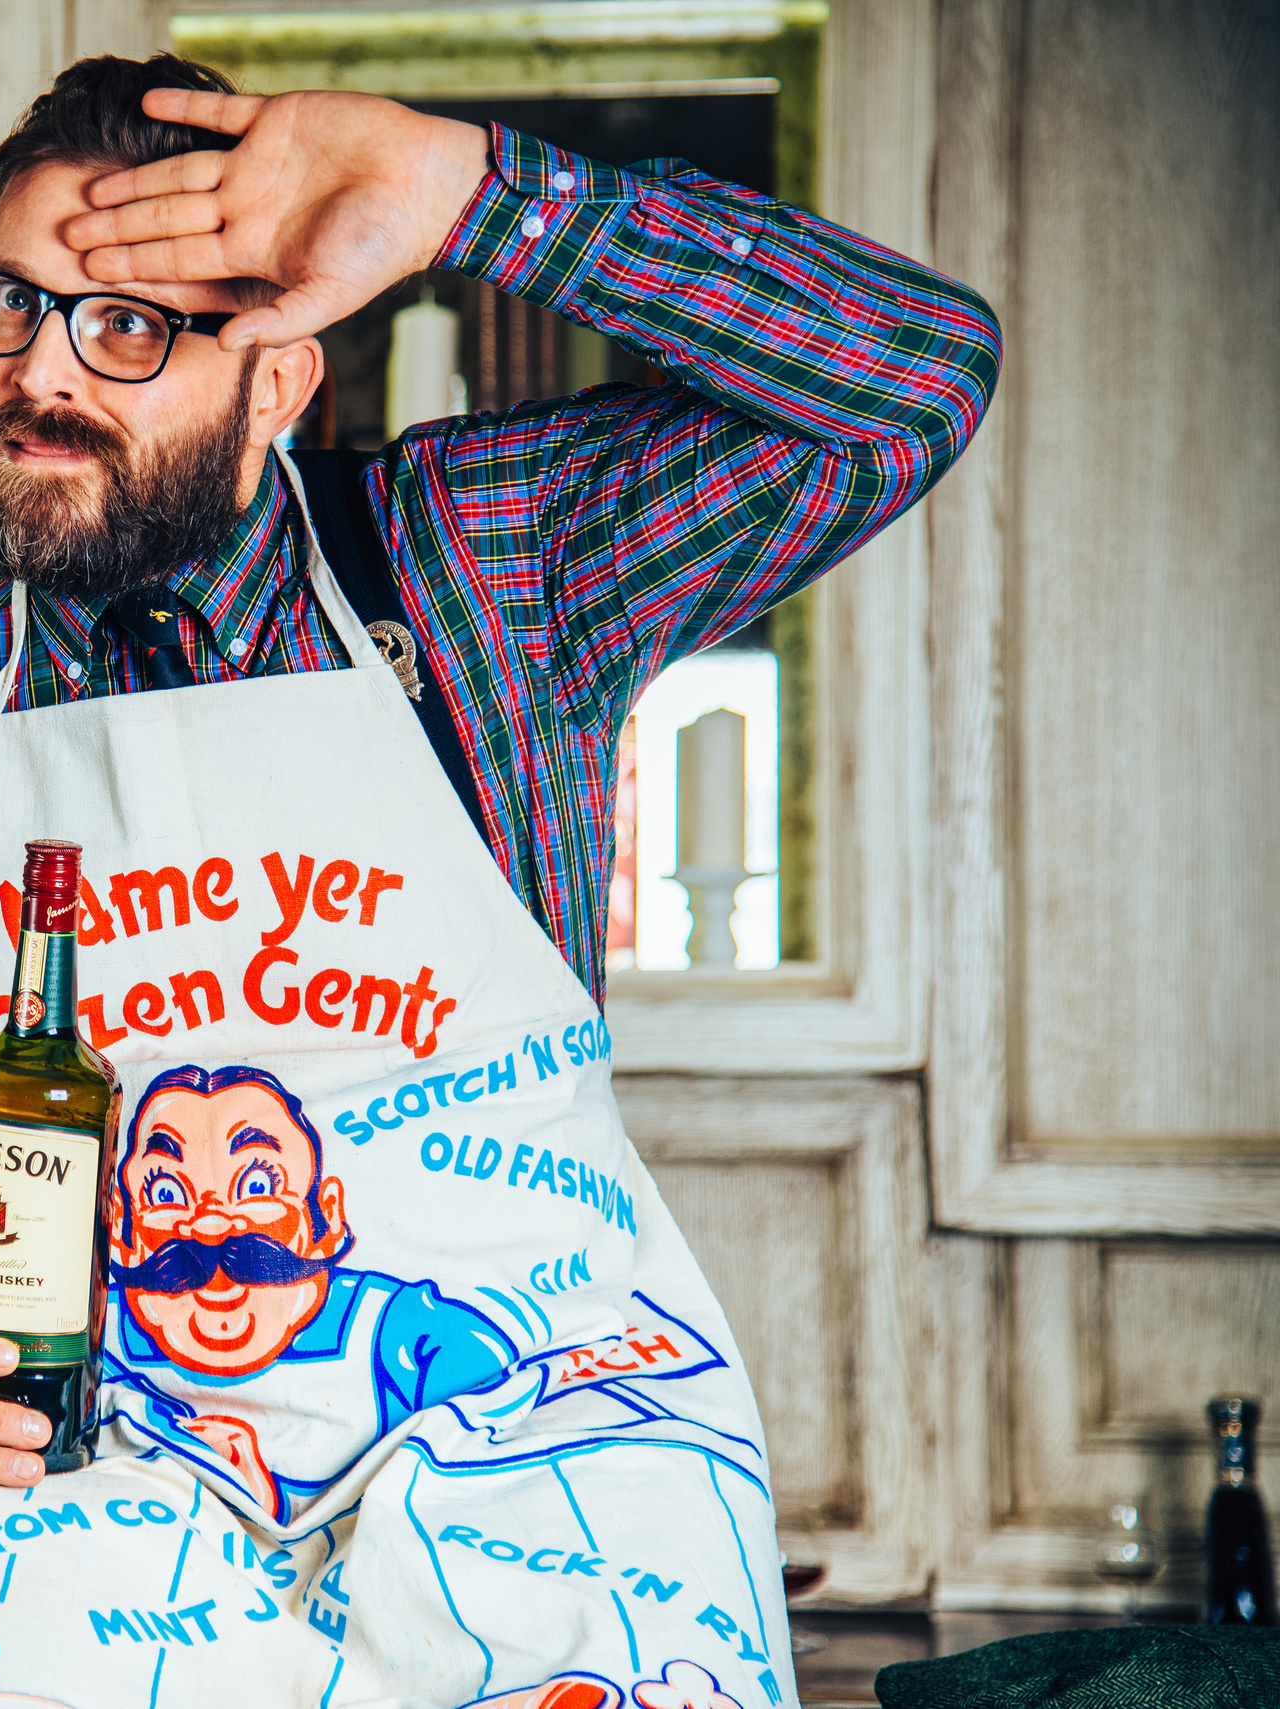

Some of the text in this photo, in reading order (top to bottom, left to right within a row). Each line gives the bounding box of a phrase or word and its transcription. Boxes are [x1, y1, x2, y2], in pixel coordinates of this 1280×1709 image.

[260, 851, 404, 947] yer
[242, 946, 458, 1060] Gents
[333, 1053, 517, 1146] SCOTCH
[420, 1132, 502, 1180] OLD
[0, 1294, 25, 1302] BOTTLED
[530, 1247, 593, 1295] GIN
[88, 1598, 219, 1646] MINT
[437, 1524, 784, 1707] ROCK 'N RYE
